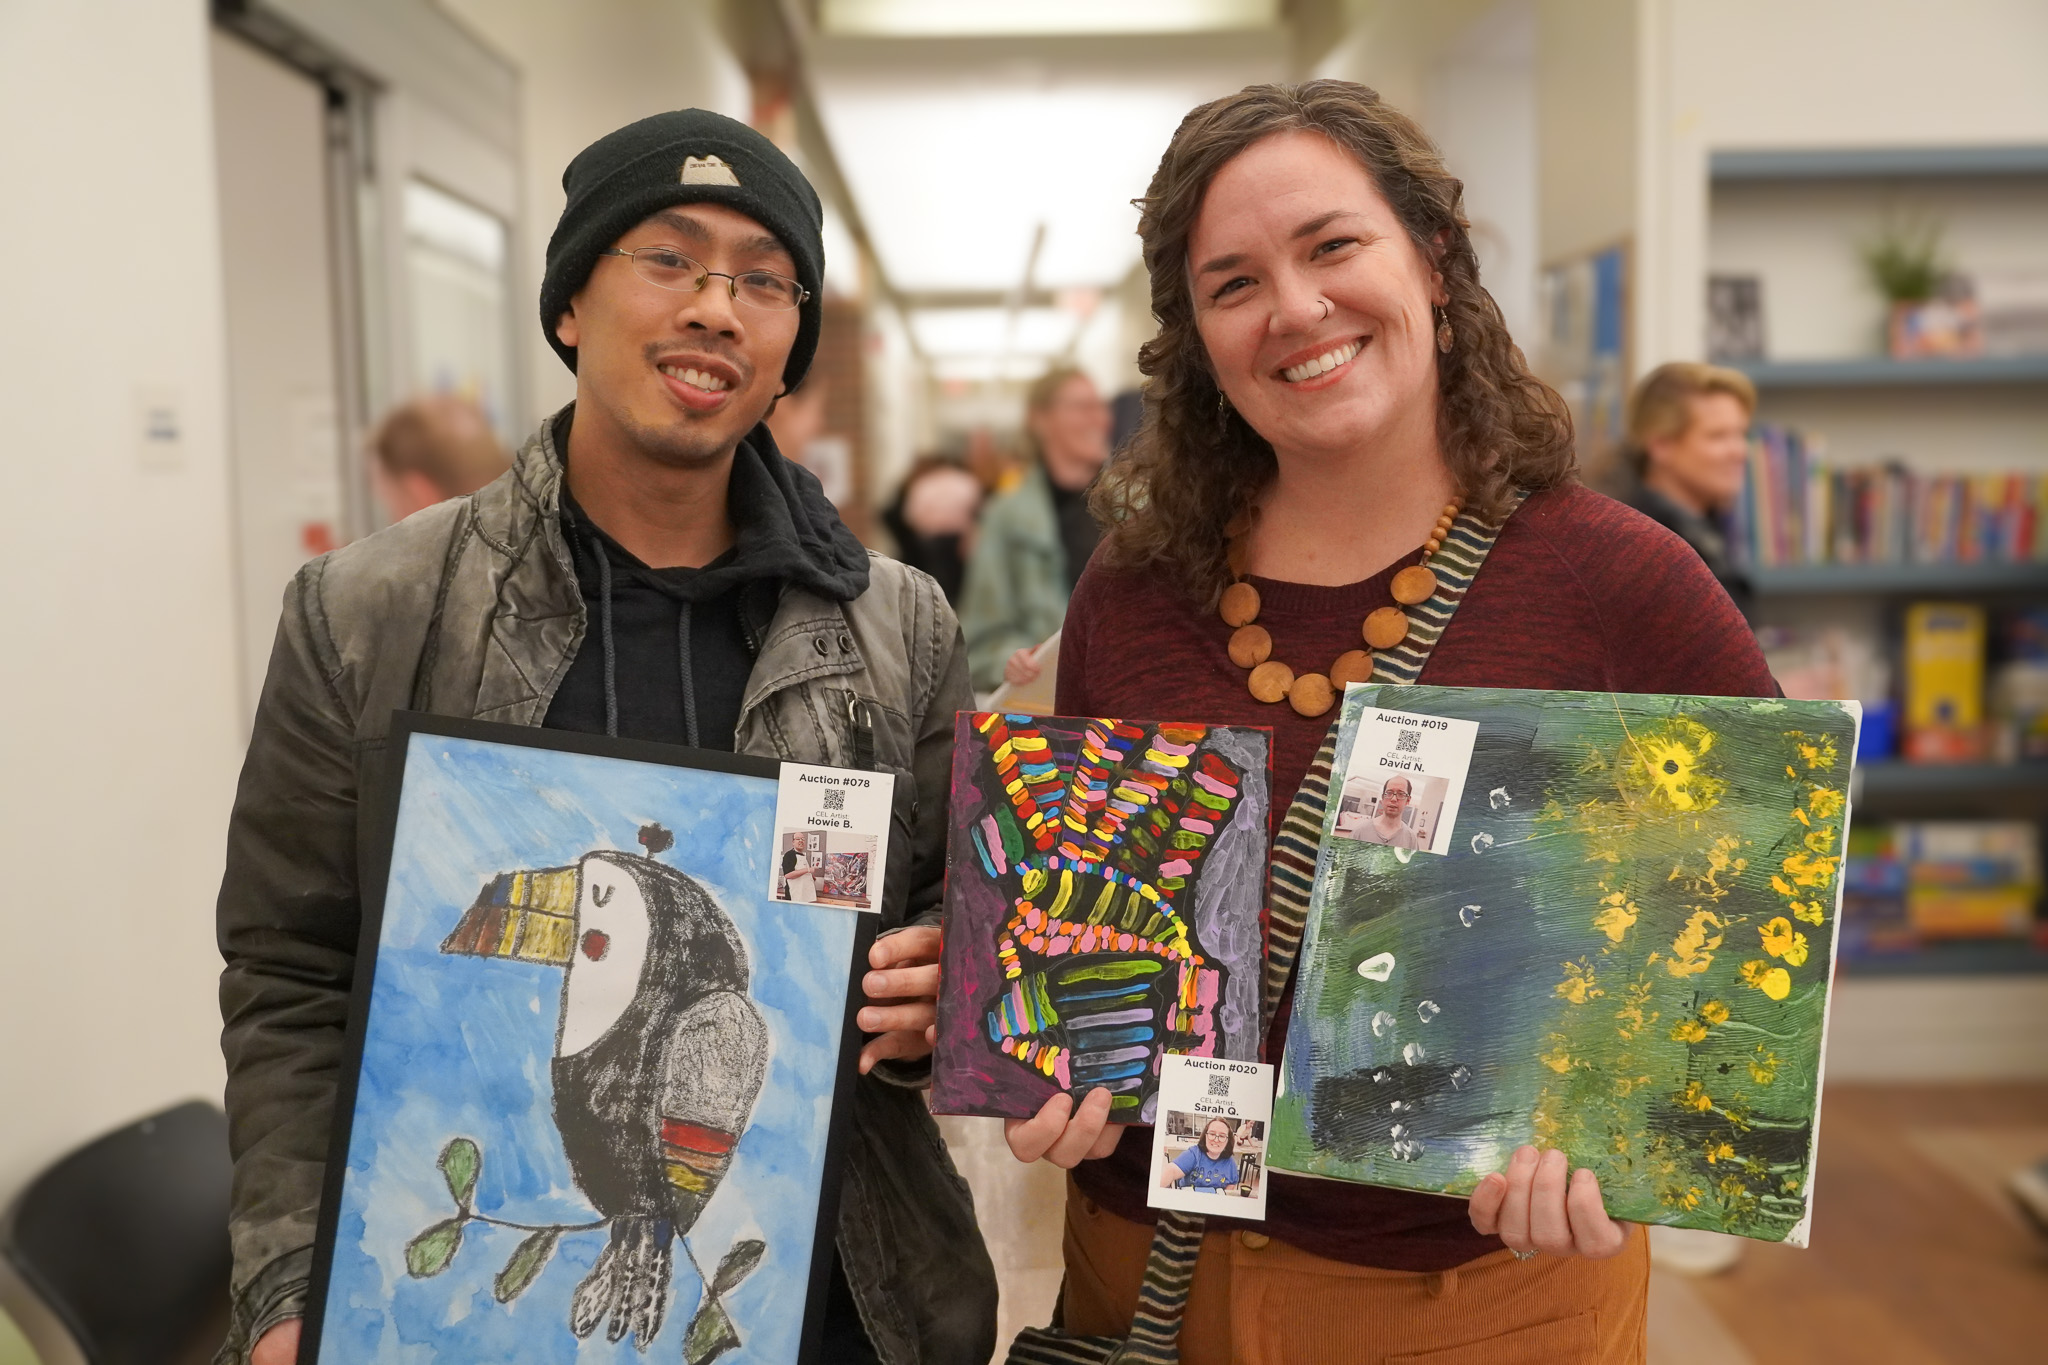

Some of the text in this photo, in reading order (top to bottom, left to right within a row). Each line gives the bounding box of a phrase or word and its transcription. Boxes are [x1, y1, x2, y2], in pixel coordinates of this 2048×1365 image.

[1376, 713, 1448, 731] Auction #019
[1379, 757, 1425, 773] David N.
[799, 773, 870, 788] Auction #078
[815, 810, 850, 820] CEL Artist:
[807, 816, 853, 829] Howie B.
[1184, 1058, 1258, 1075] Auction #020
[1200, 1096, 1213, 1104] CEL
[1194, 1102, 1239, 1116] Sarah Q.
